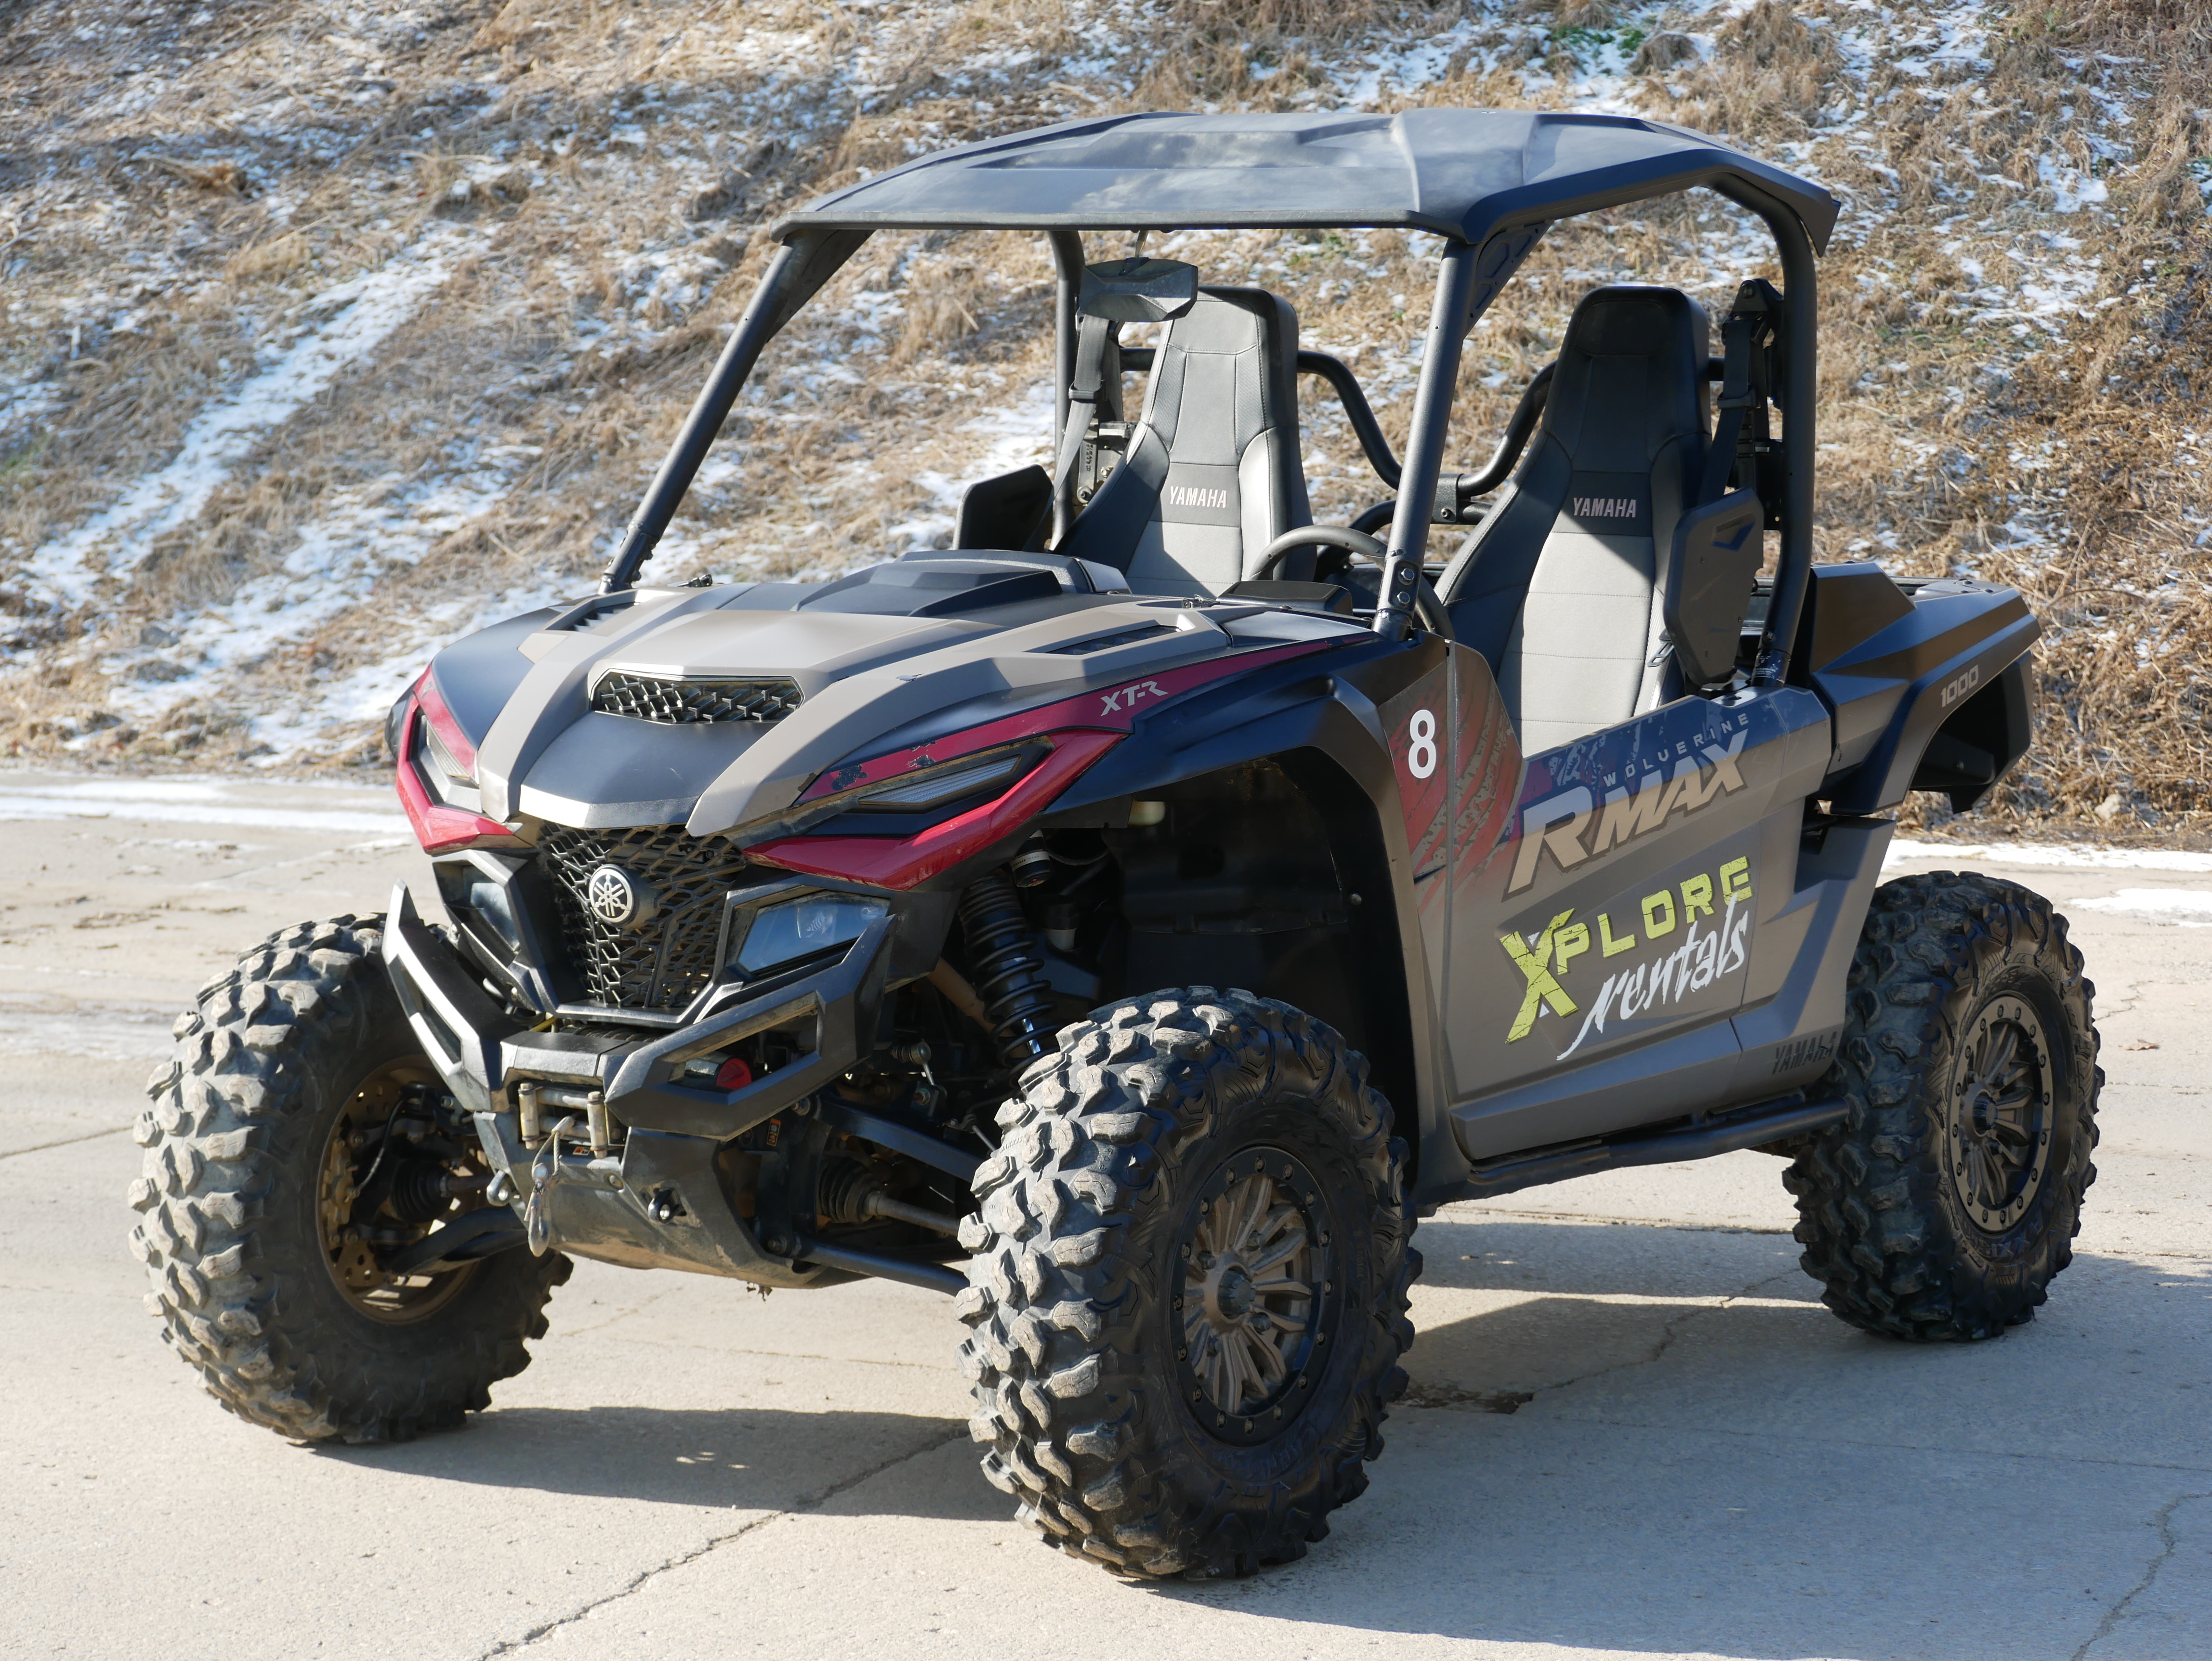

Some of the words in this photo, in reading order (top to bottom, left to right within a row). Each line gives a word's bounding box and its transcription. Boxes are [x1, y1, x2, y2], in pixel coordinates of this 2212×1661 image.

[1170, 486, 1227, 509] YAMAHA
[1573, 497, 1637, 518] YAMAHA
[1940, 664, 1979, 707] 1000
[1408, 709, 1437, 779] 8
[1603, 713, 1749, 787] WOLVERINE
[1502, 728, 1749, 900] RMAX
[1499, 856, 1754, 1044] XPLORE
[1556, 892, 1748, 1060] rentals
